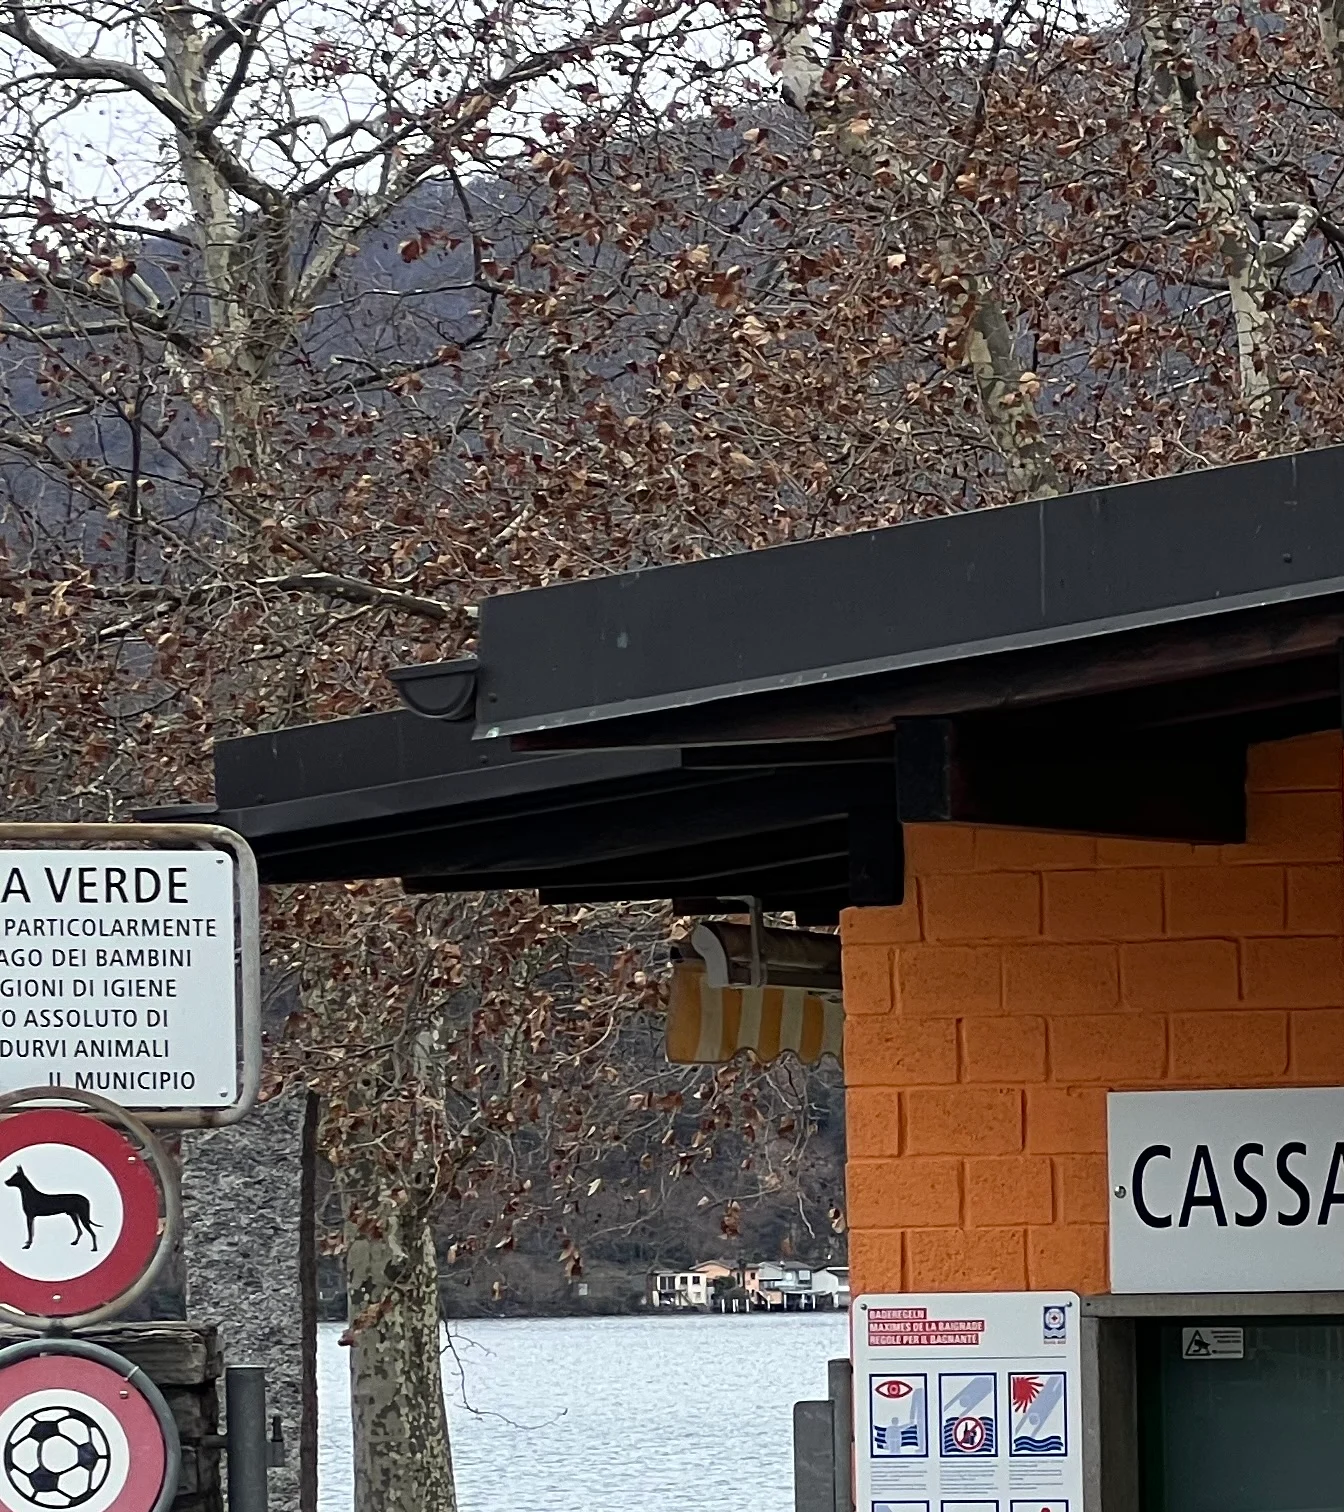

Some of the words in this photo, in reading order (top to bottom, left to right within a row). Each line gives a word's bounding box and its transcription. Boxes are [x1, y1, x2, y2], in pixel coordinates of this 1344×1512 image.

[1, 867, 31, 903] A
[44, 867, 188, 903] VERDE
[5, 918, 216, 937] PARTICOLARMENTE
[52, 949, 87, 967] DEI
[96, 949, 192, 967] BAMBINI
[0, 979, 63, 998] GIONI
[73, 979, 94, 997] DI
[103, 979, 177, 998] IGIENE
[0, 1009, 16, 1028] O
[23, 1009, 138, 1028] ASSOLUTO
[146, 1009, 168, 1028] DI
[0, 1039, 66, 1058] DURVI
[74, 1039, 169, 1058] ANIMALI
[75, 1071, 195, 1090] MUNICIPIO
[912, 1322, 923, 1332] DE
[925, 1322, 937, 1332] LA
[902, 1335, 919, 1344] PER
